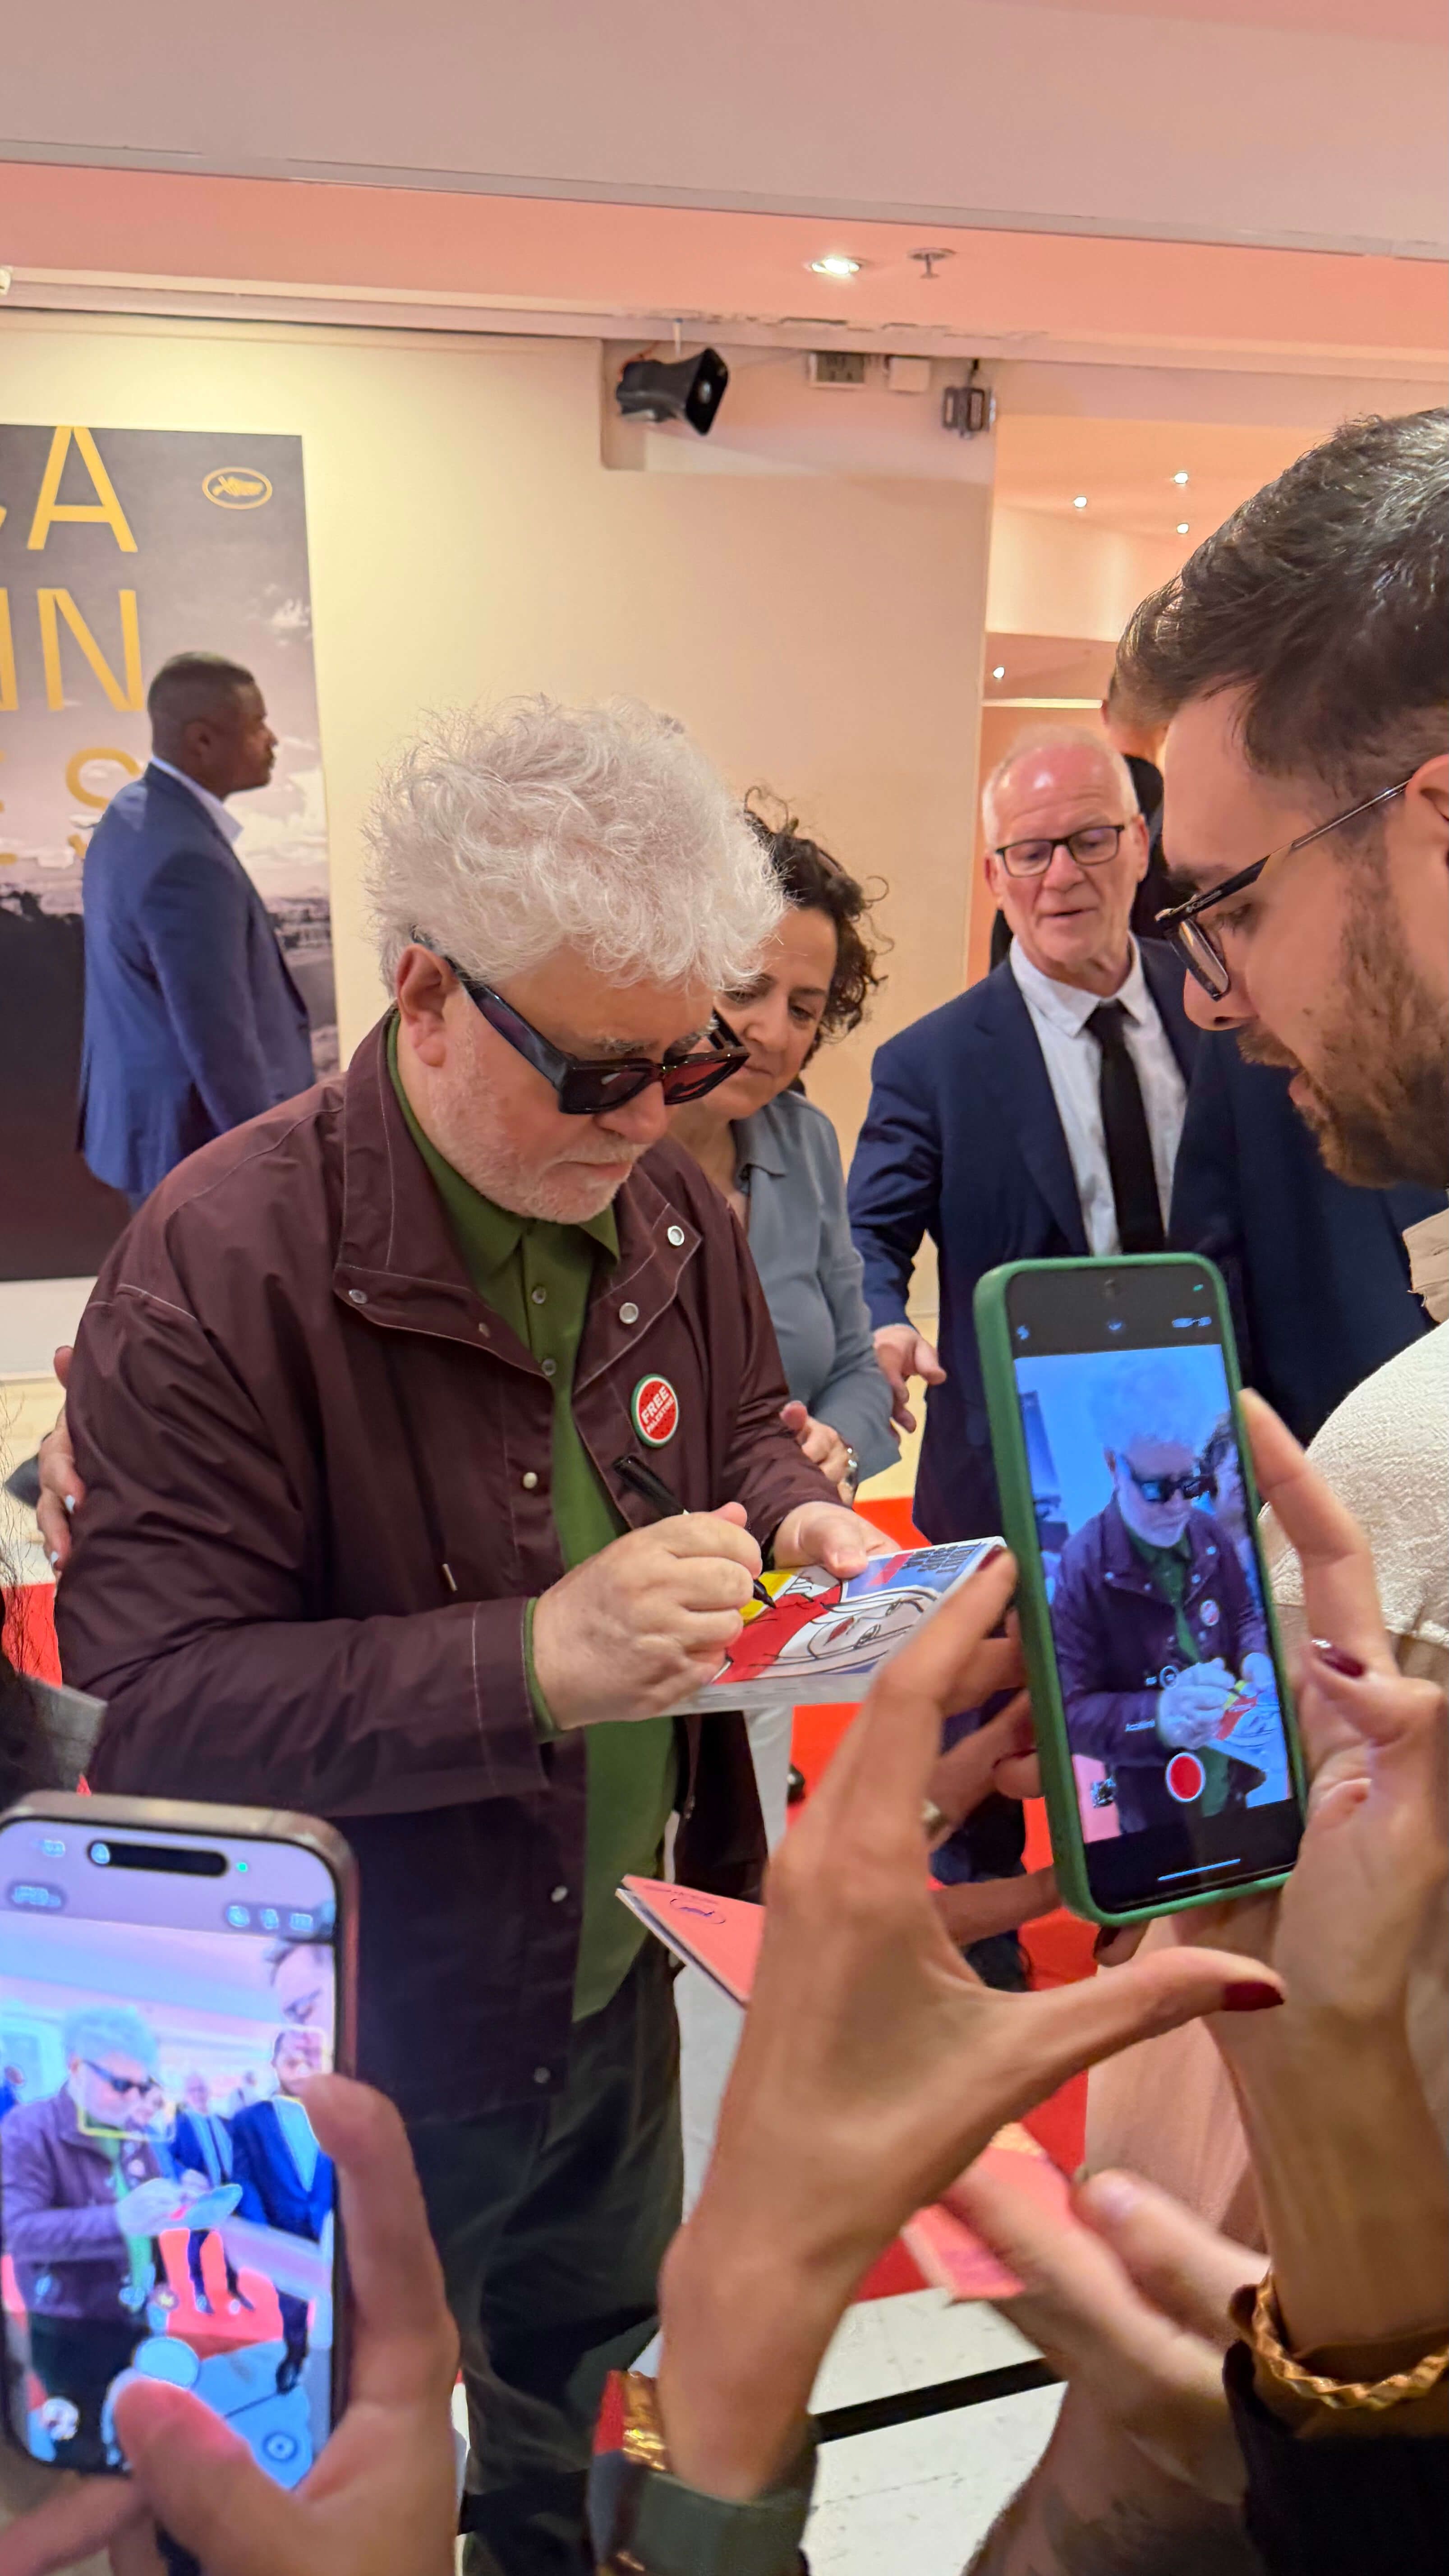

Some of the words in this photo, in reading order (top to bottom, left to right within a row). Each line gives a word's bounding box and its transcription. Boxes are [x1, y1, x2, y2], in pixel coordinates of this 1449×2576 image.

[0, 425, 138, 552] A
[0, 587, 144, 712] N
[641, 1386, 669, 1425] FREE
